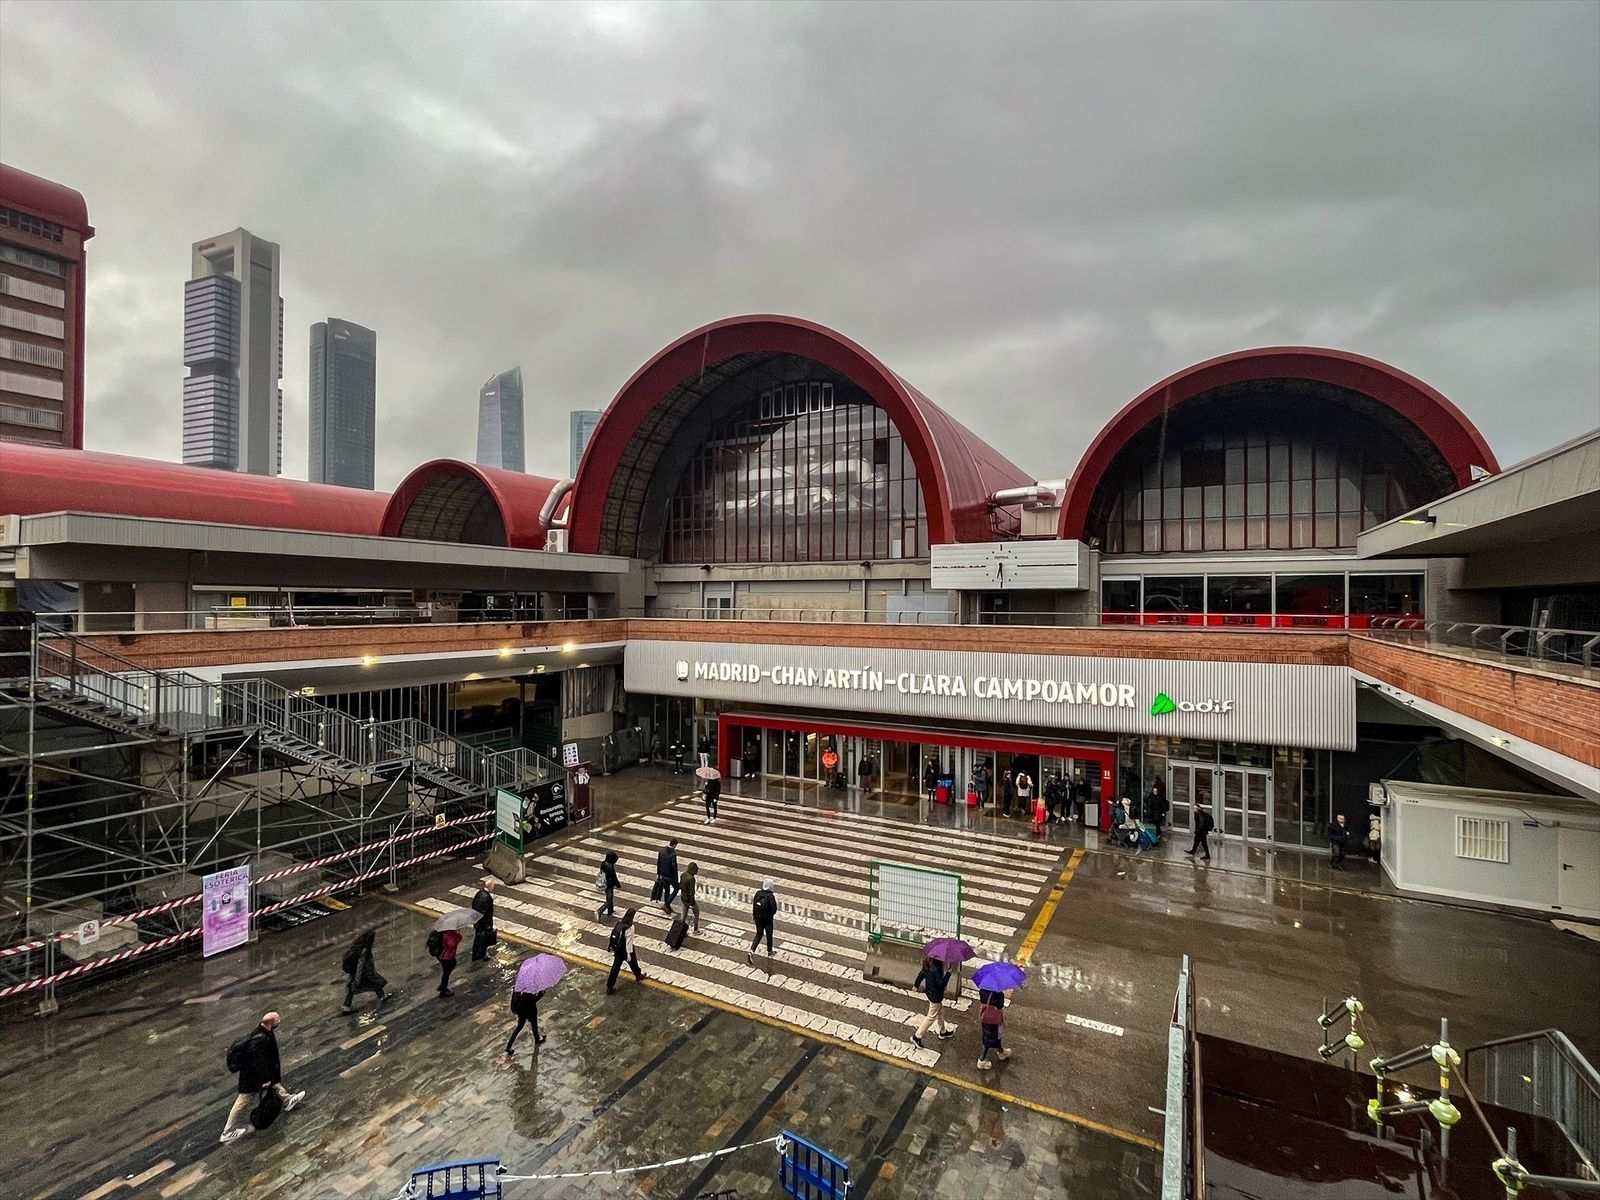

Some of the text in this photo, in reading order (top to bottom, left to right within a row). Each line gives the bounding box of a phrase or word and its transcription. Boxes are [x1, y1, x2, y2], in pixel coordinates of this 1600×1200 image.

[973, 676, 1136, 708] CAMPOAMOR
[1178, 698, 1234, 713] adif
[215, 869, 238, 880] FERIA
